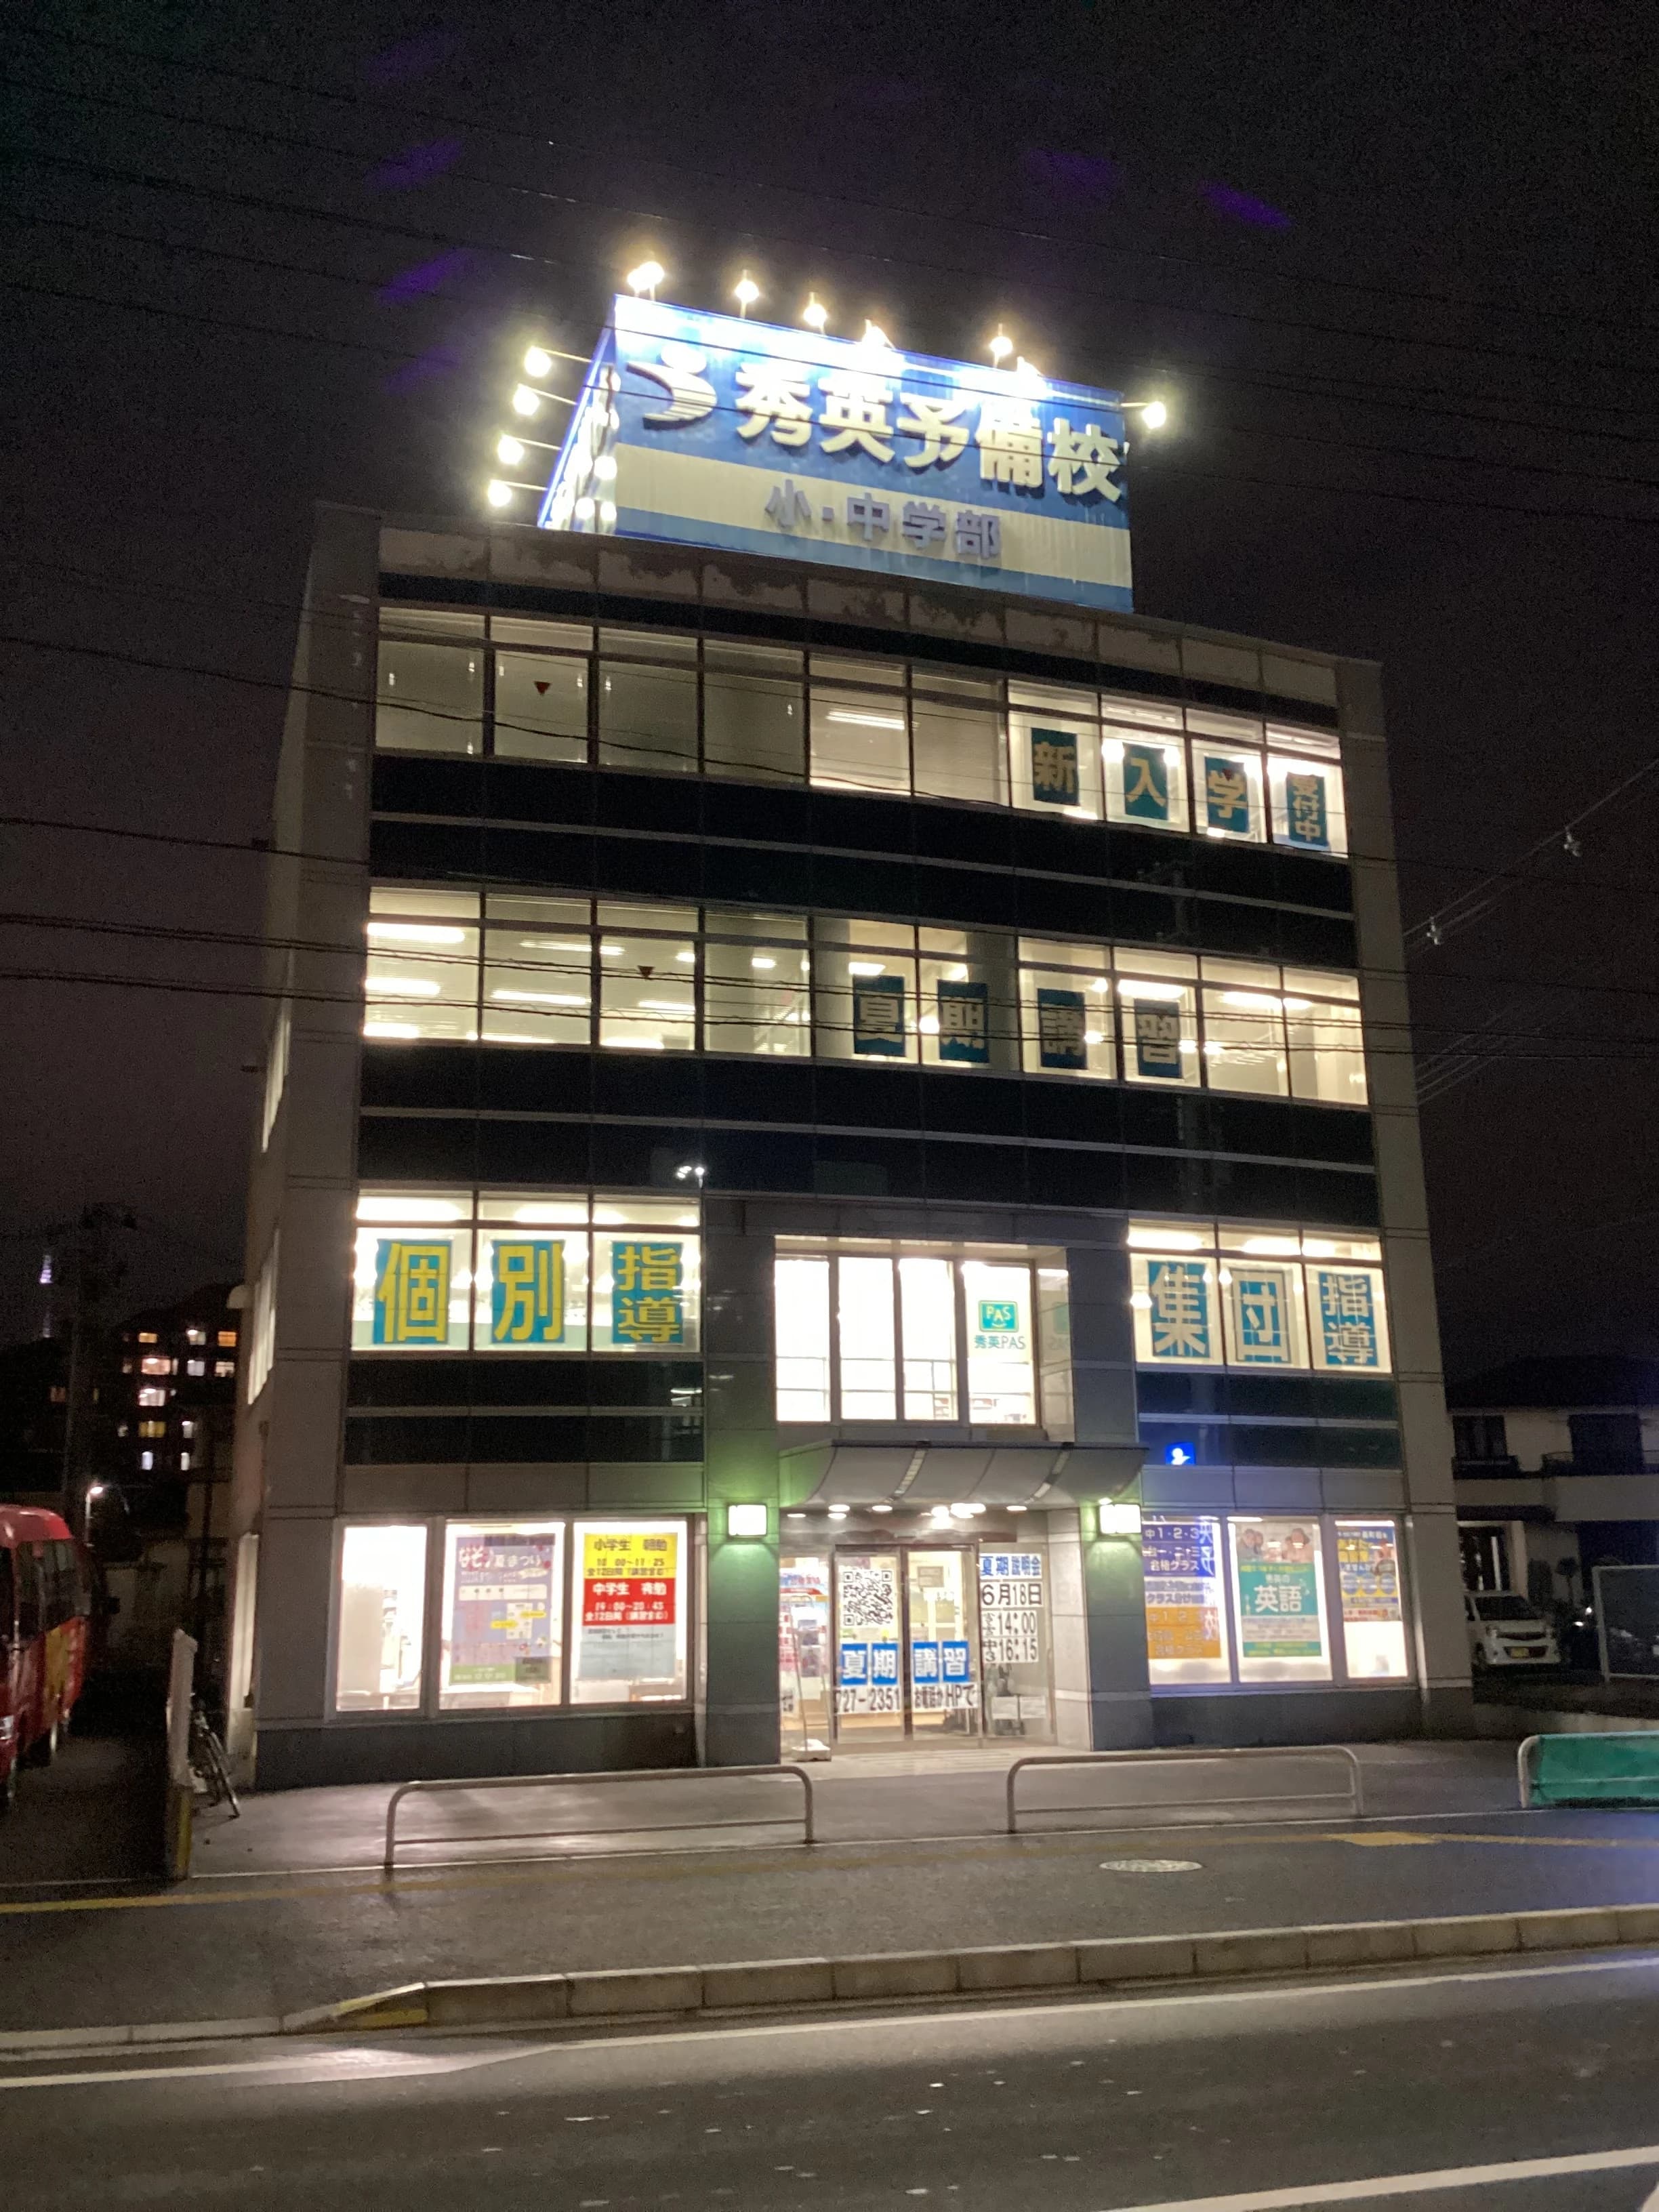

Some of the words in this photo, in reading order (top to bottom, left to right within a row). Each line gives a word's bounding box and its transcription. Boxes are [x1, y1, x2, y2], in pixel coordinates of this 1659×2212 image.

[737, 363, 1126, 504] 秀英予備校
[766, 478, 1002, 561] 小・中学部
[617, 1244, 680, 1343] 指導
[985, 1305, 1011, 1321] PAS
[1322, 1275, 1374, 1366] 指導
[974, 1334, 1026, 1349] 秀英PAS
[980, 1556, 1040, 1576] 夏期説明会
[592, 1582, 630, 1596] 中学生
[982, 1583, 1042, 1605] 6月18日
[1253, 1585, 1303, 1612] 英語
[998, 1612, 1036, 1637] 14:00
[999, 1638, 1037, 1661] 16:15
[842, 1648, 967, 1679] 夏期講習
